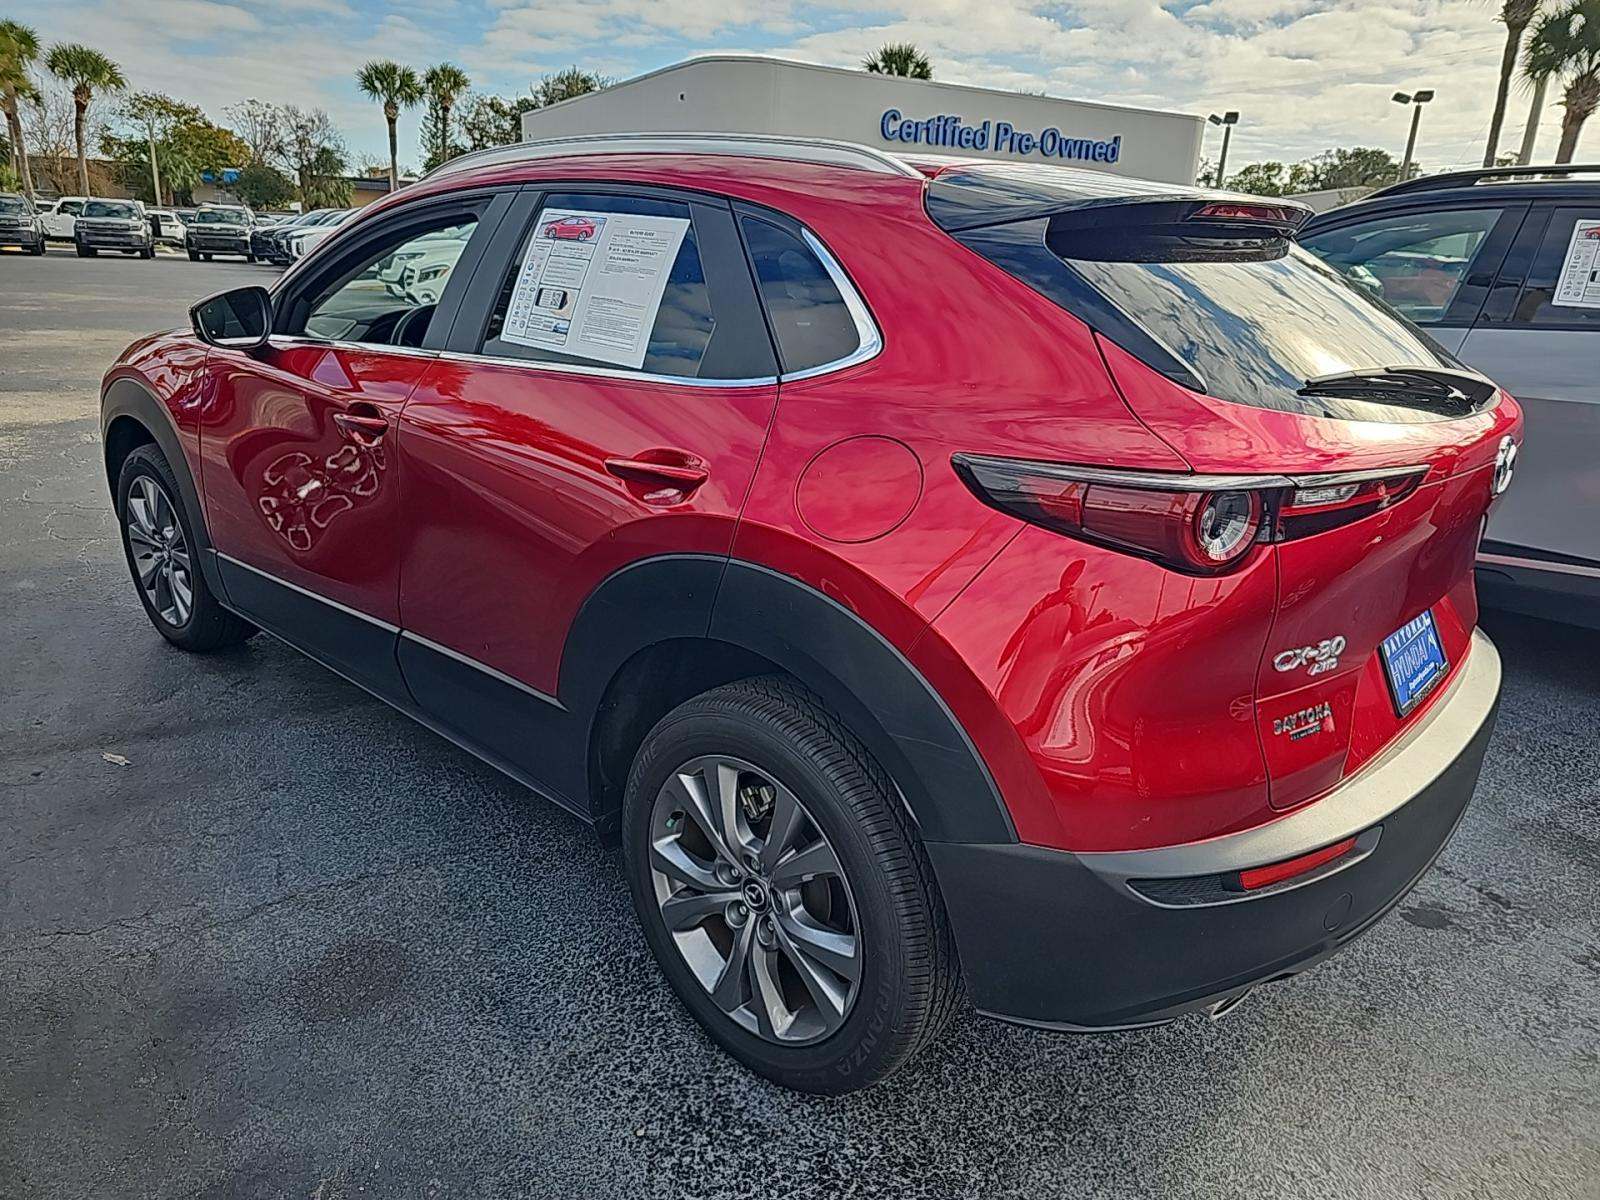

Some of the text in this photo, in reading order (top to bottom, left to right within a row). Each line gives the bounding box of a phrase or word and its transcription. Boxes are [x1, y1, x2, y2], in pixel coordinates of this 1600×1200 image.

[881, 108, 1121, 163] Certified Pre-Owned
[1273, 635, 1346, 672] CX-30
[1384, 614, 1425, 657] DAYTONA
[1390, 636, 1429, 689] HYUNDAI
[1273, 701, 1332, 735] DAYTONA
